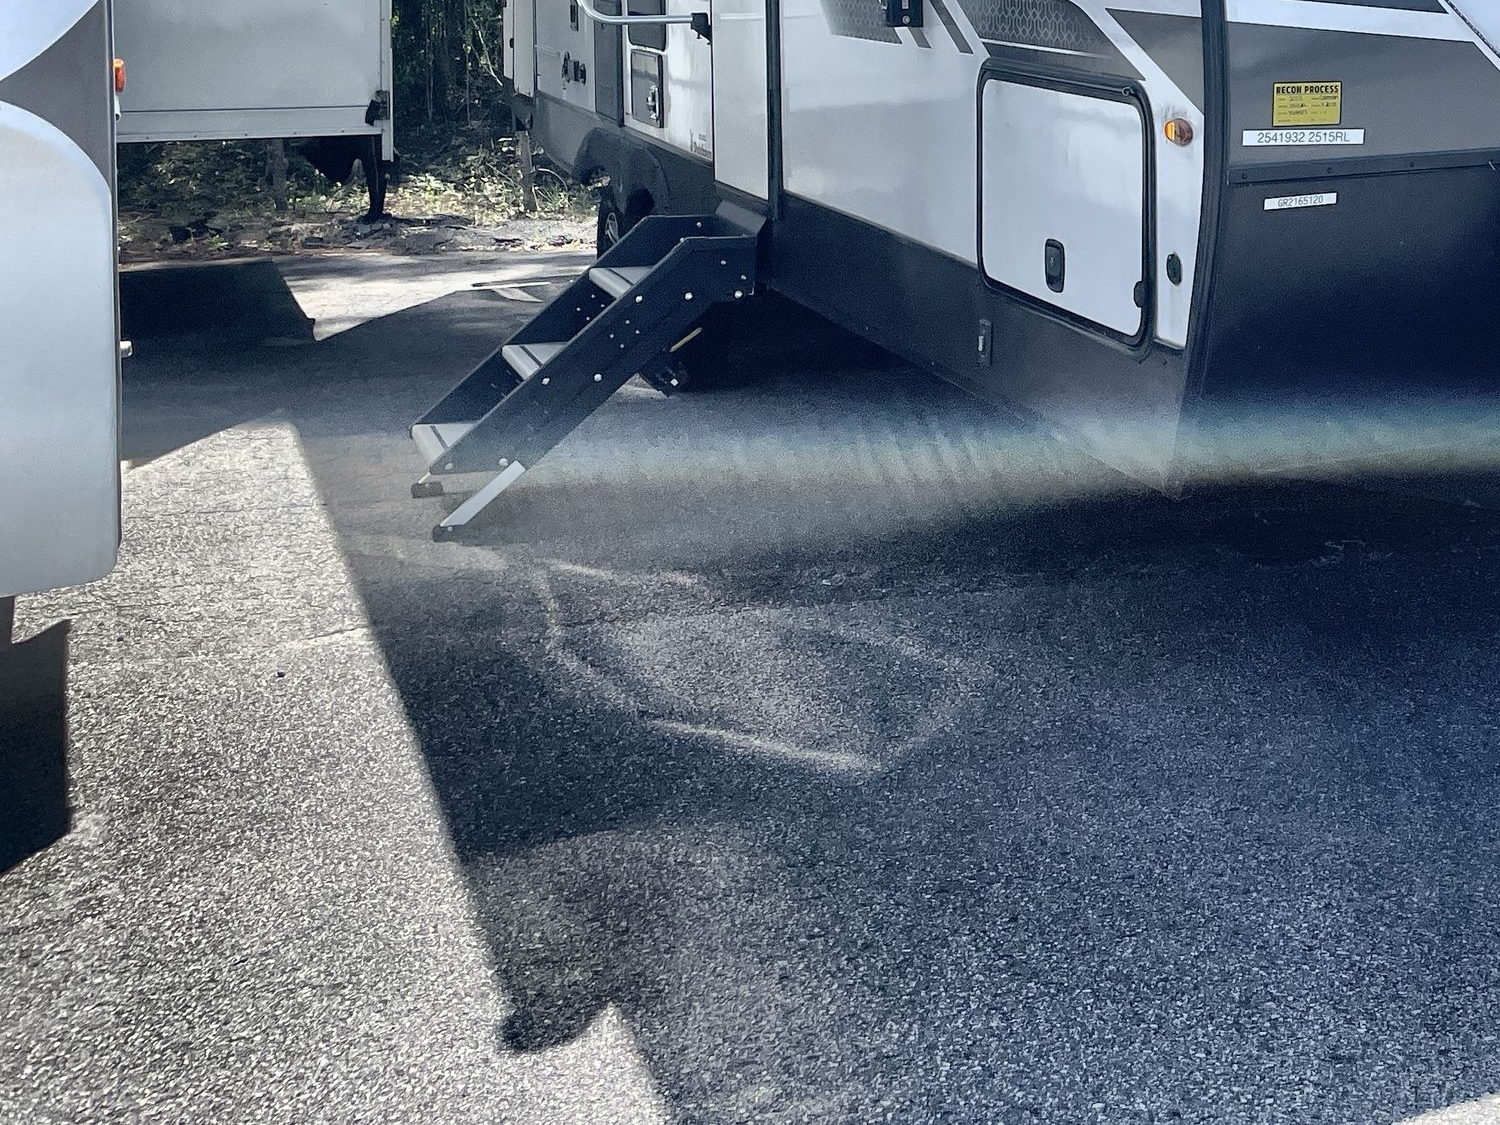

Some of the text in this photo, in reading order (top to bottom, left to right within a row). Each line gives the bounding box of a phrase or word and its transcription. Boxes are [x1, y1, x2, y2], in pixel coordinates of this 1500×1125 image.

[1276, 85, 1339, 94] RECON PROCESS
[1257, 131, 1350, 144] 2541932 2515RL
